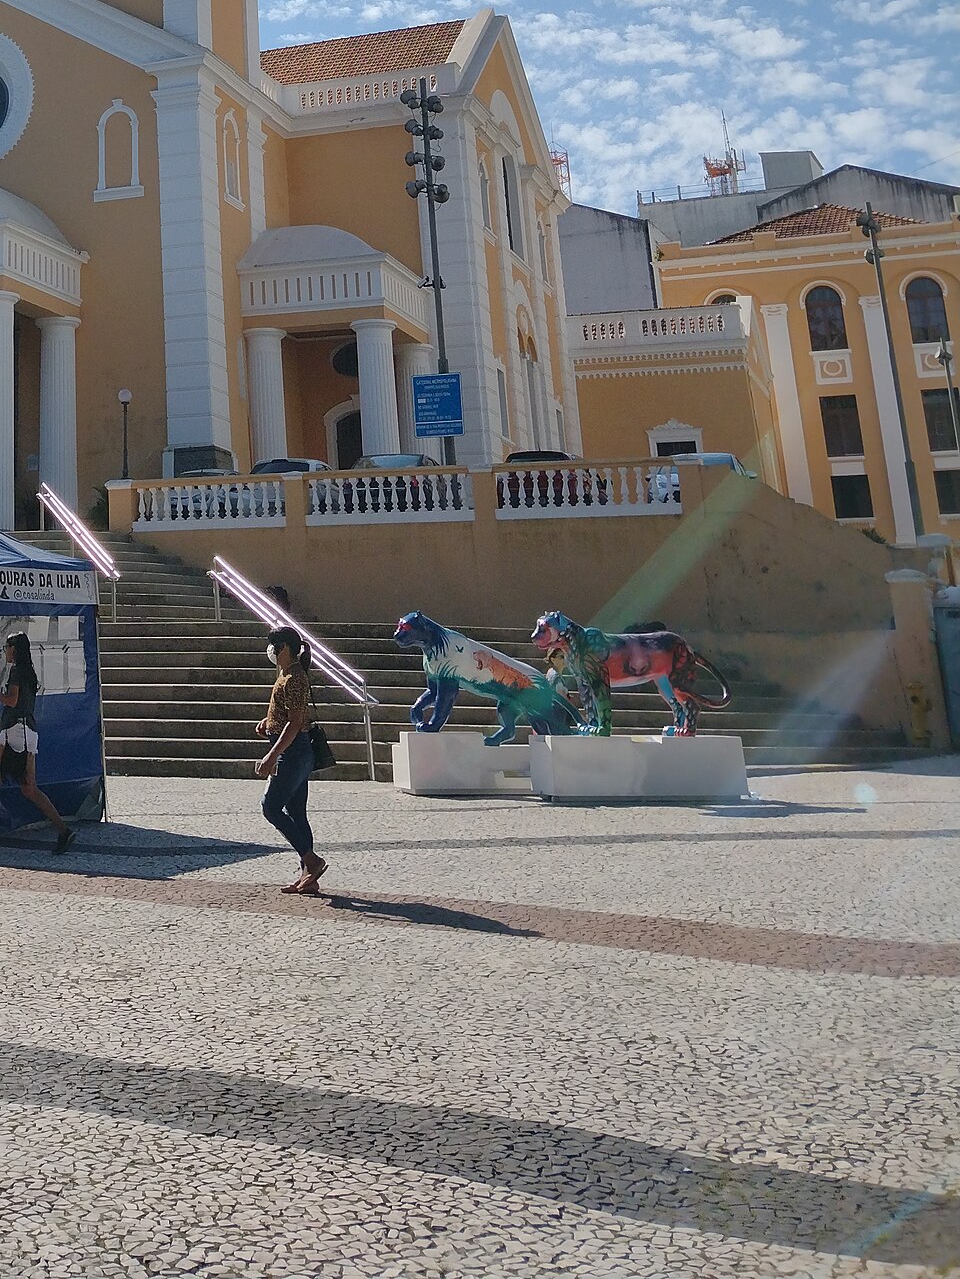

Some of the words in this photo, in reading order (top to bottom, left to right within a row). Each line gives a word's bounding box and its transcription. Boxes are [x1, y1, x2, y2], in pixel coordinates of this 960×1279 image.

[39, 573, 53, 588] DA
[56, 574, 81, 589] ILHA
[13, 588, 55, 601] @cosalinda
